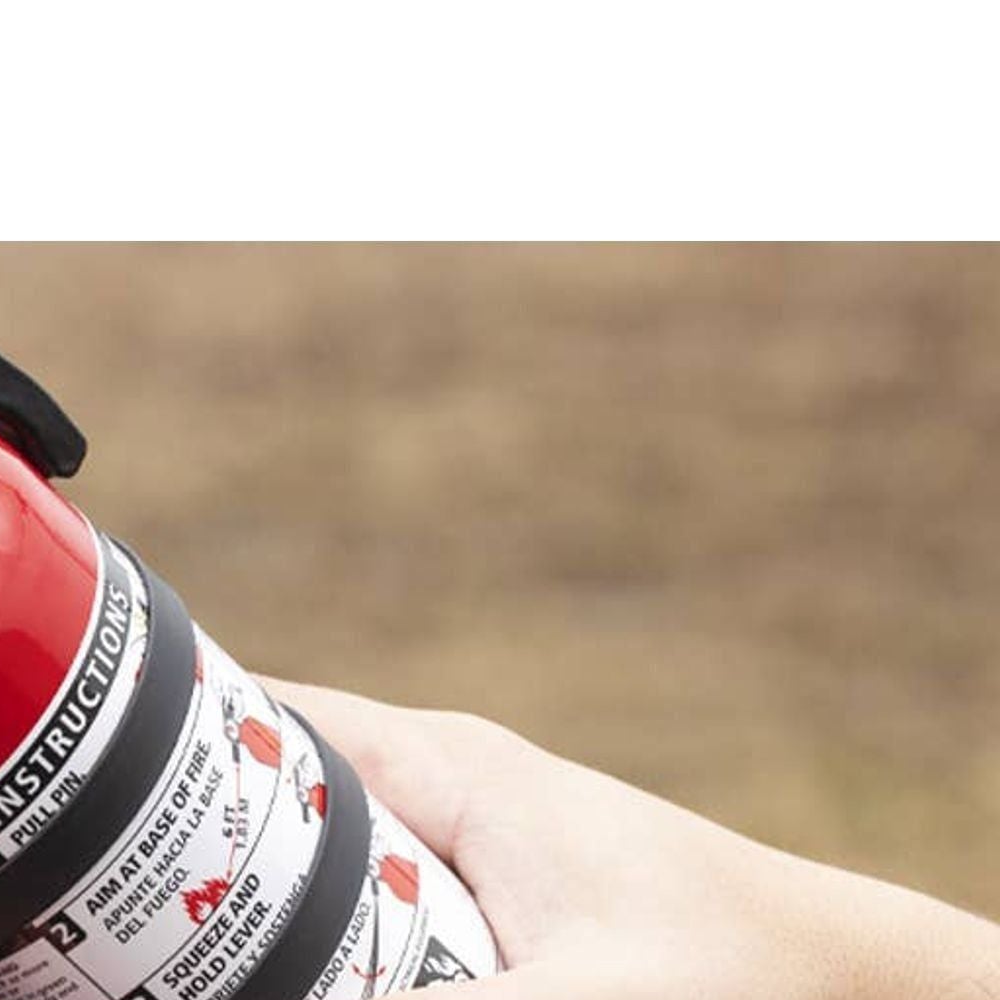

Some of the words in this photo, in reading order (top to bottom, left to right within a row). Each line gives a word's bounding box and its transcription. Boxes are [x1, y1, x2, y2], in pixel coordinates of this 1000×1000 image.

[10, 803, 53, 847] PULL
[50, 769, 87, 804] PIN.
[51, 922, 77, 946] 2
[85, 878, 123, 917] AIM
[119, 853, 143, 884] AT
[138, 807, 178, 859] BASE
[171, 780, 192, 810] OF
[185, 739, 211, 784] FIRE.
[102, 873, 156, 932] APUNTE
[152, 829, 191, 878] HACIA
[187, 807, 204, 831] LA
[200, 764, 224, 809] BASE
[114, 917, 145, 945] DEL
[143, 866, 190, 919] FUEGO.
[162, 912, 233, 989] SQUEEZE
[228, 873, 261, 919] AND
[223, 900, 273, 958] LEVER.
[244, 950, 259, 968] Y
[312, 956, 345, 1000] LADO
[340, 945, 352, 961] A
